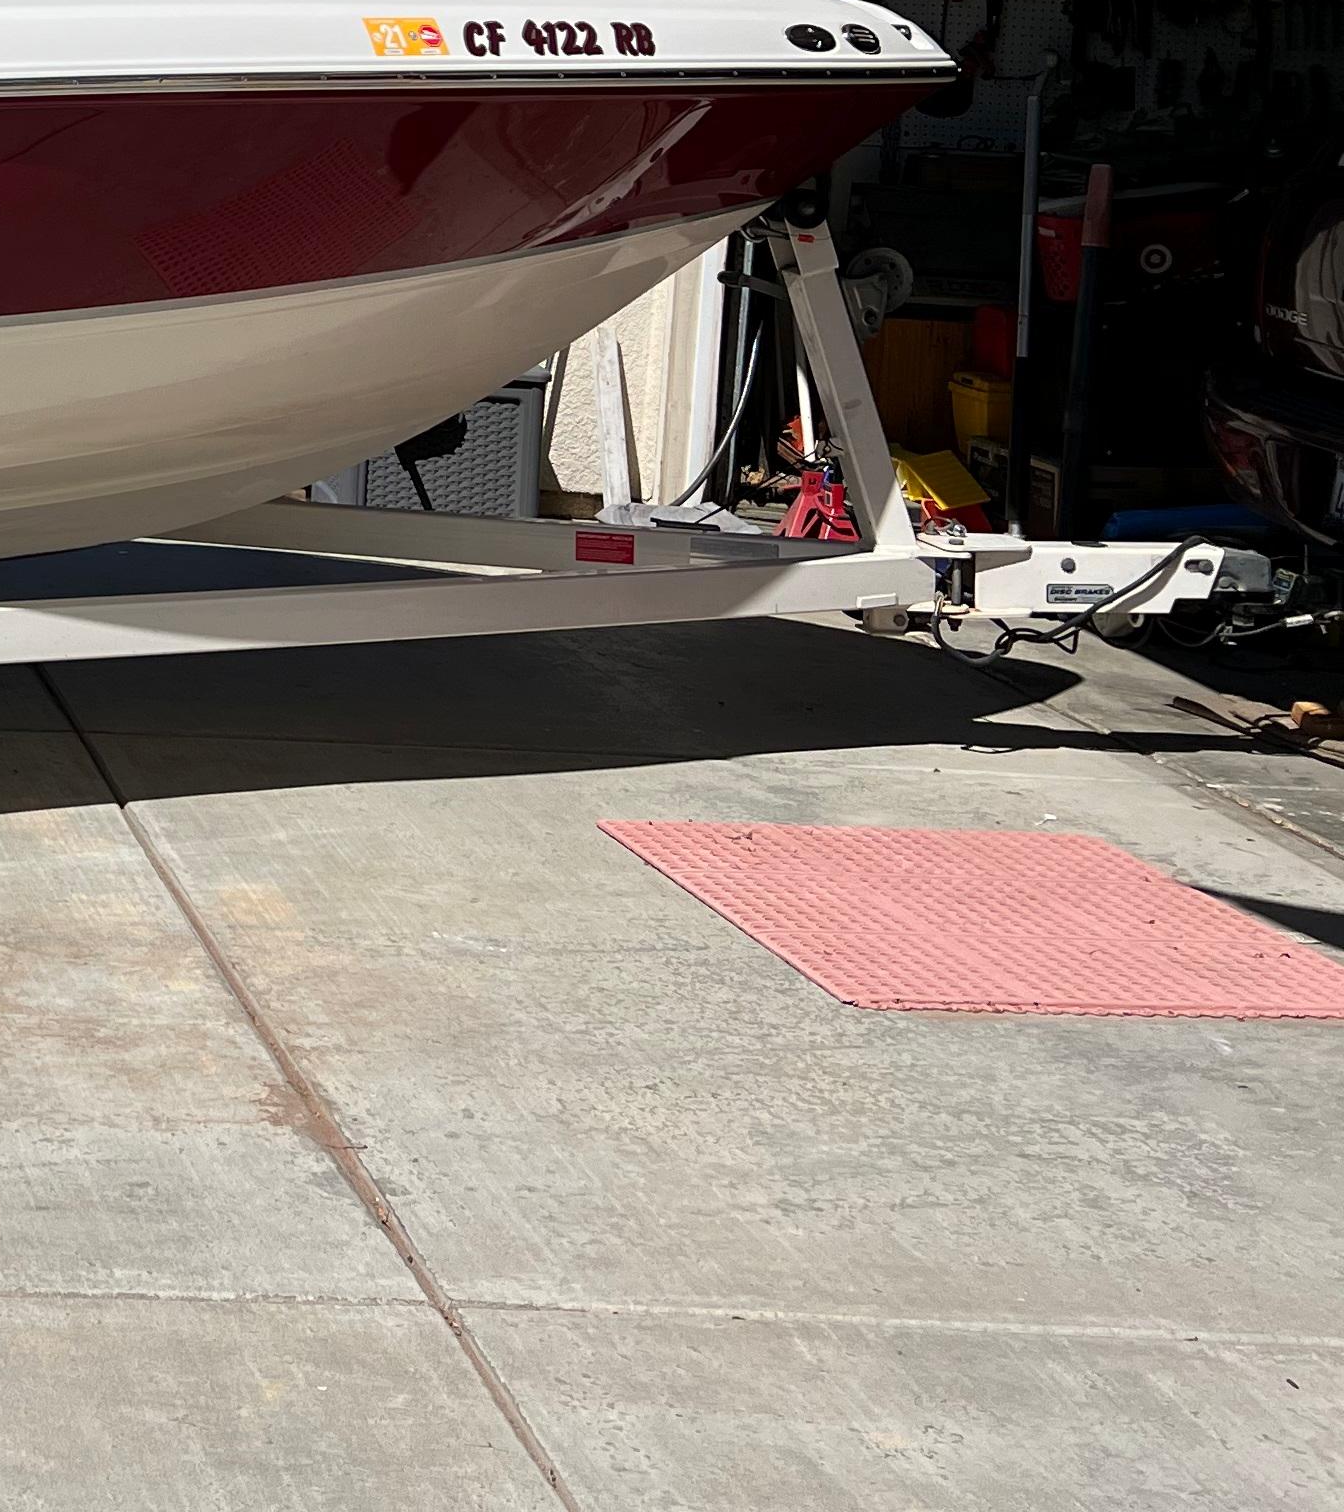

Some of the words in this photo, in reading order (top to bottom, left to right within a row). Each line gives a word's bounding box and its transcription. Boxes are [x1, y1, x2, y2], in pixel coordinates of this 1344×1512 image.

[379, 23, 408, 48] 21
[463, 20, 506, 57] CF
[521, 19, 605, 56] 4122
[610, 21, 656, 56] RB
[1264, 303, 1308, 327] DODGE
